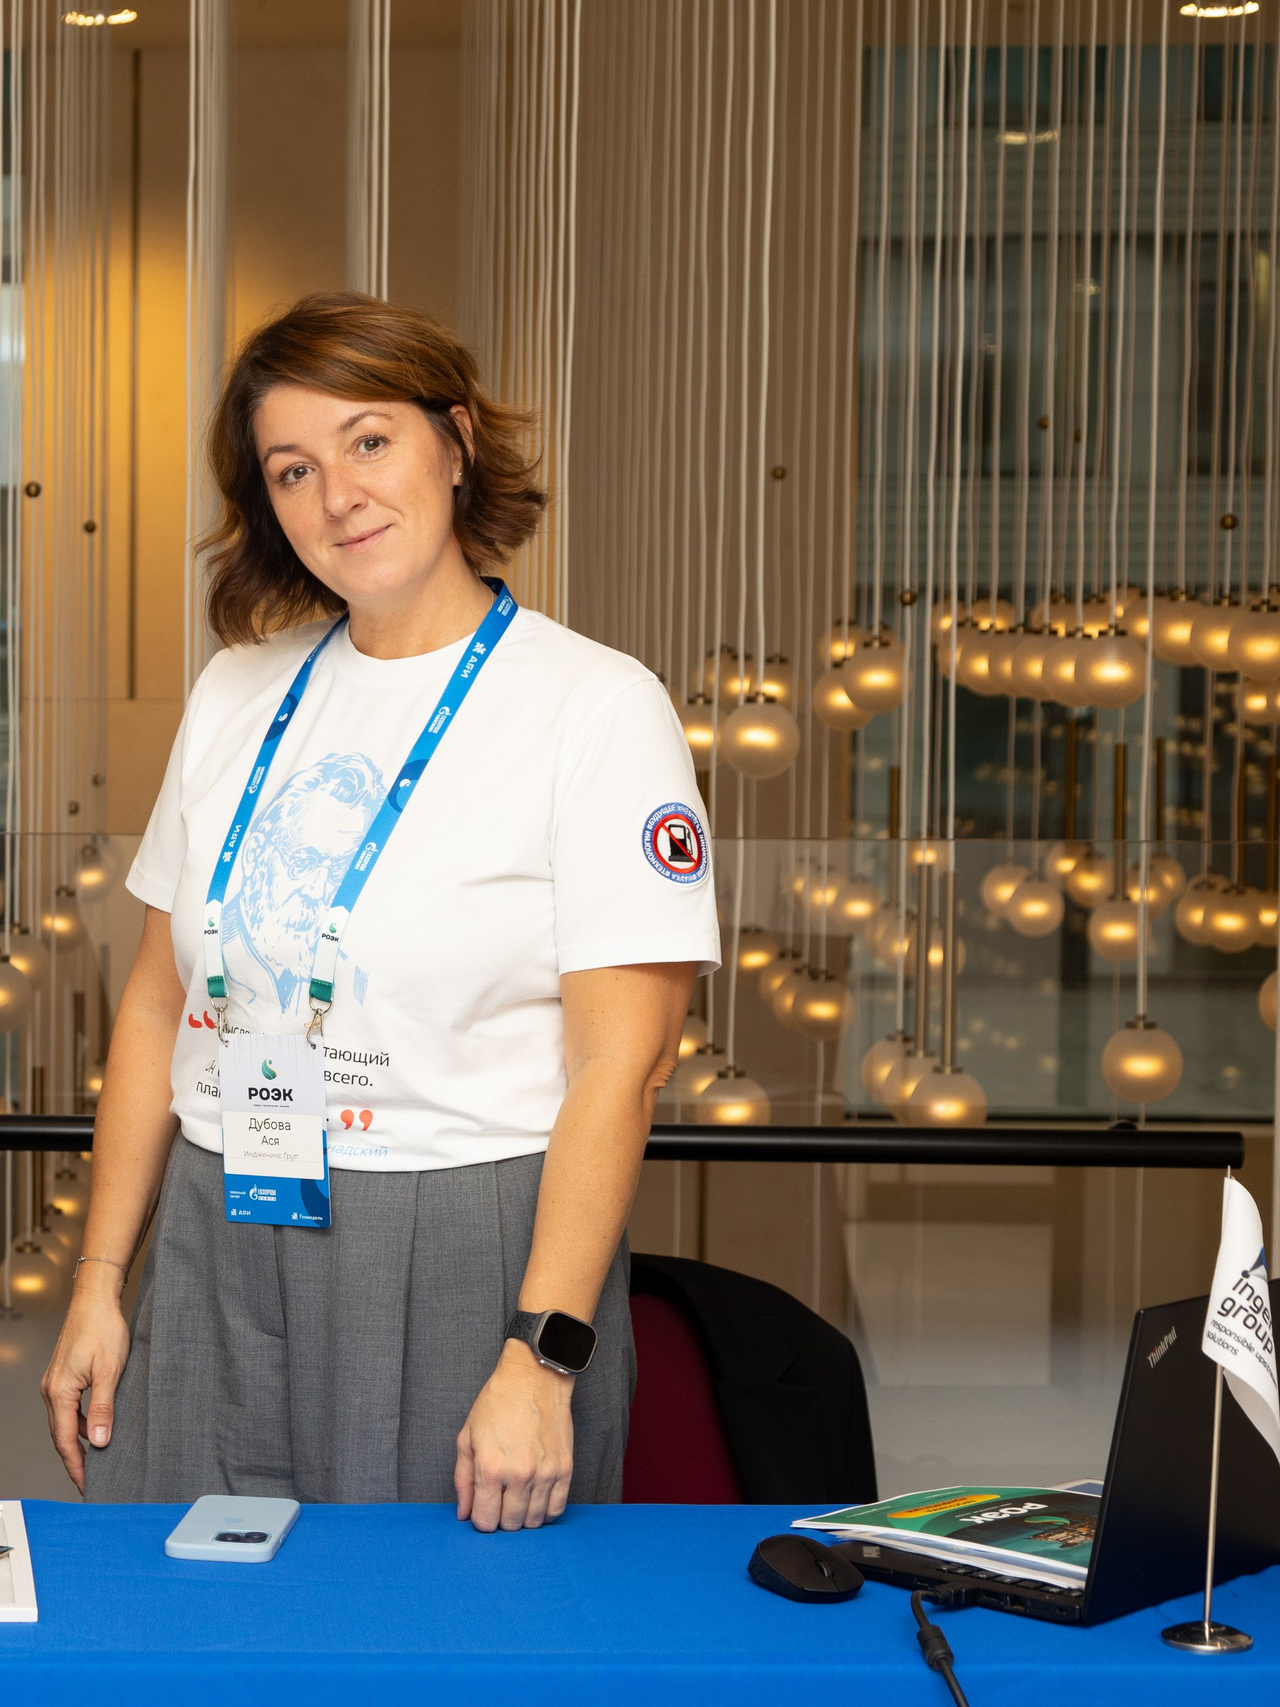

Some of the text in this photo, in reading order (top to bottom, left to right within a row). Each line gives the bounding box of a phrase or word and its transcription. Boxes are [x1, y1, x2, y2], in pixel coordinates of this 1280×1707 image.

[321, 933, 339, 943] РОЭК
[324, 1070, 373, 1087] всего.
[196, 1081, 220, 1098] пла
[248, 1087, 293, 1101] РОЭК
[248, 1118, 291, 1132] Дубова
[261, 1135, 280, 1146] Ася
[243, 1150, 298, 1161] Индженикс Груп
[1217, 1297, 1274, 1355] group
[1206, 1330, 1239, 1356] solutions
[1211, 1319, 1255, 1353] responsible
[1147, 1326, 1178, 1369] ThinkPad
[959, 1502, 1048, 1524] РОЭК
